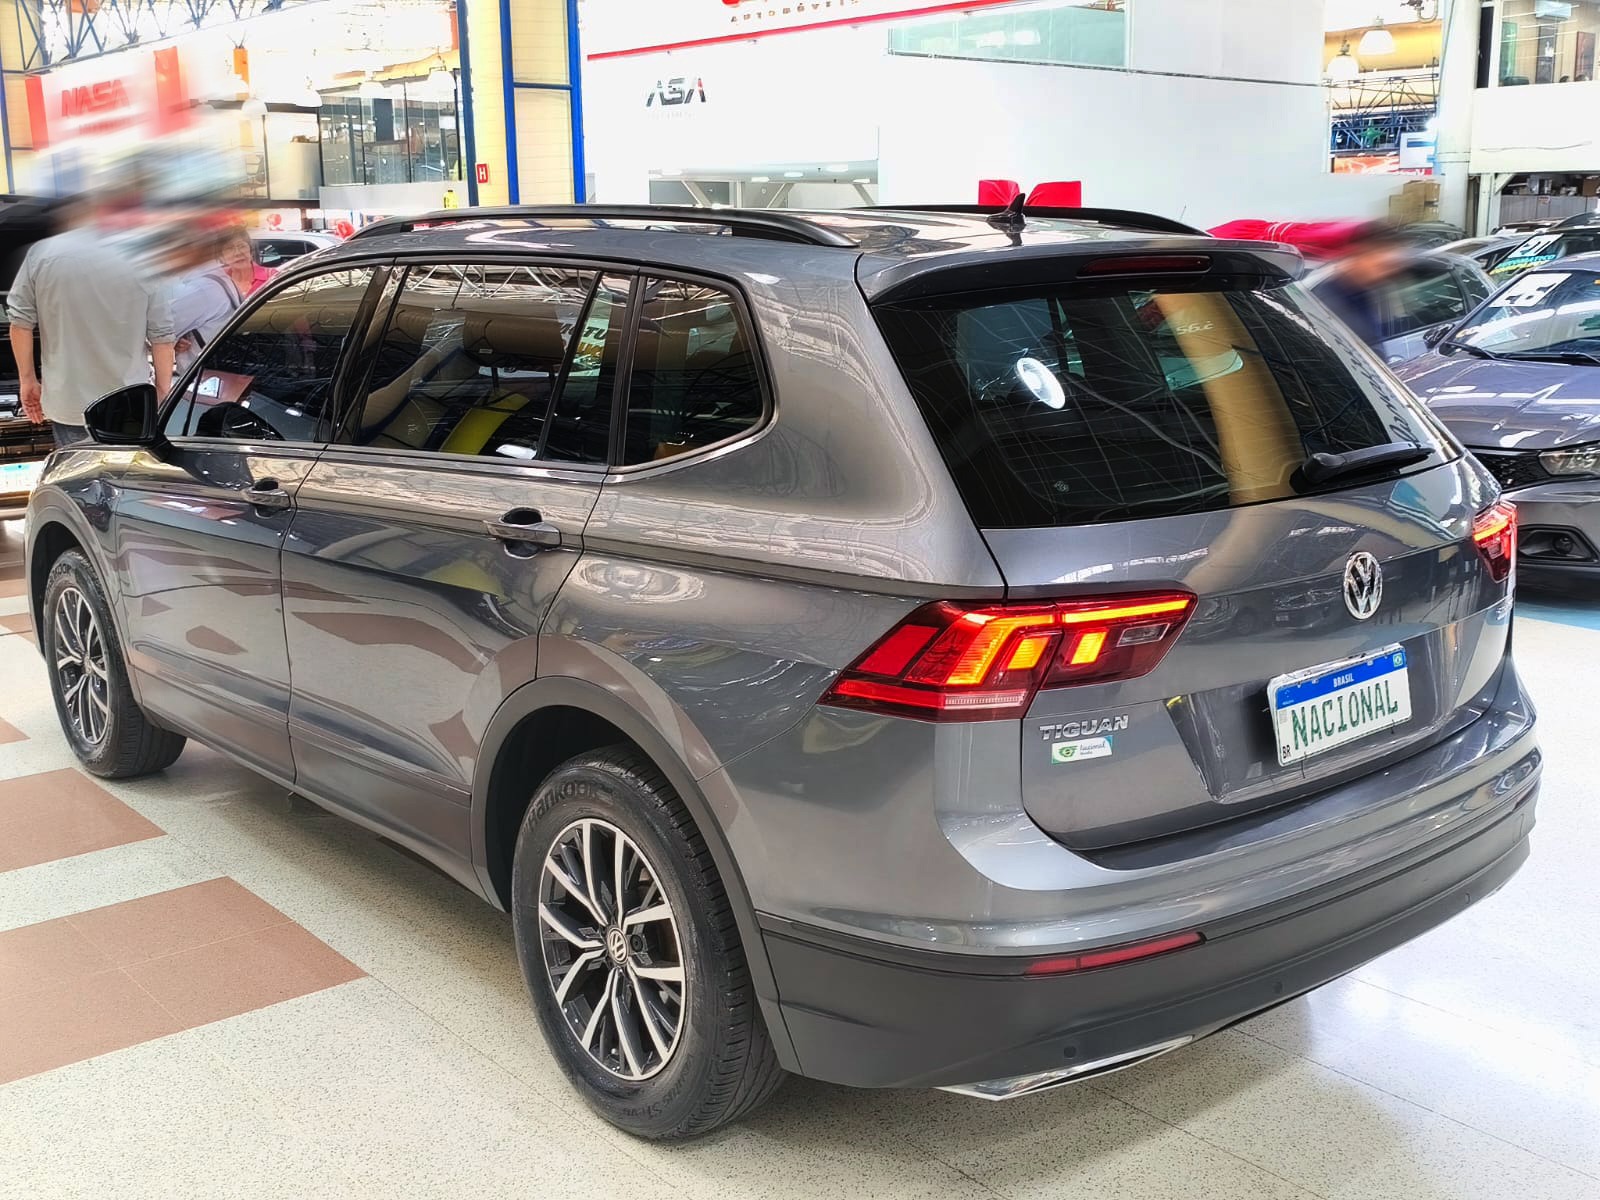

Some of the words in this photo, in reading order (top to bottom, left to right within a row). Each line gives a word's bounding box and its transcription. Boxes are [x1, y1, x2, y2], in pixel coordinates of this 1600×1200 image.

[61, 79, 130, 117] NASA
[645, 77, 706, 107] ASA
[1332, 673, 1355, 688] BRASIL
[1039, 714, 1129, 740] TIGUAN
[1291, 679, 1399, 751] NACIONAL
[1282, 744, 1291, 759] BR
